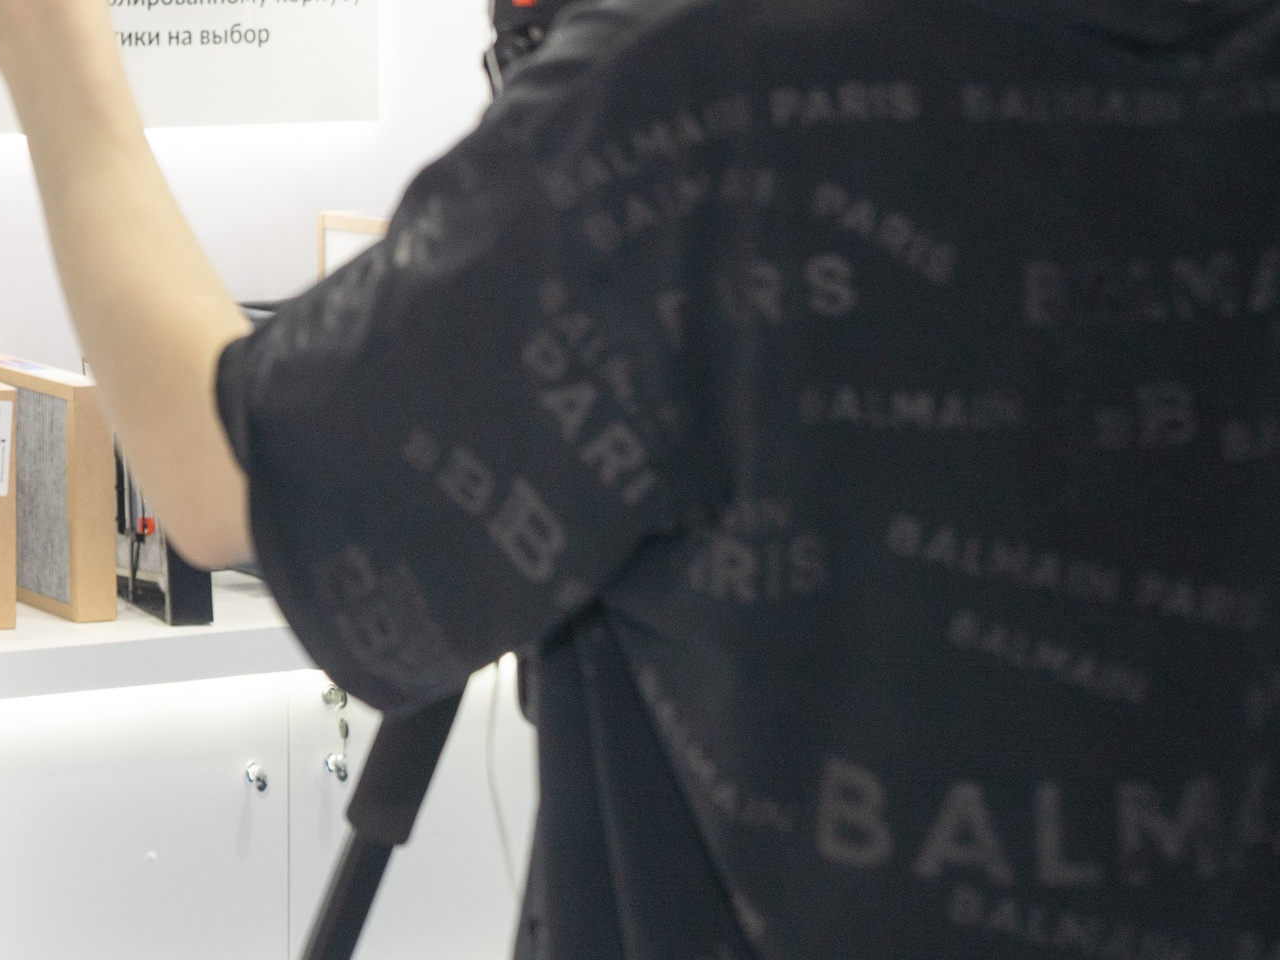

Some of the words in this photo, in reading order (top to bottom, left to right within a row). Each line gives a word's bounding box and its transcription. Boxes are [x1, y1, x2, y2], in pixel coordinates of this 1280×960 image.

[168, 29, 193, 46] на
[199, 22, 270, 48] выбор
[768, 78, 920, 127] PARIS
[810, 180, 958, 286] PARIS
[487, 472, 568, 584] B
[885, 512, 1122, 604] BALMAIN
